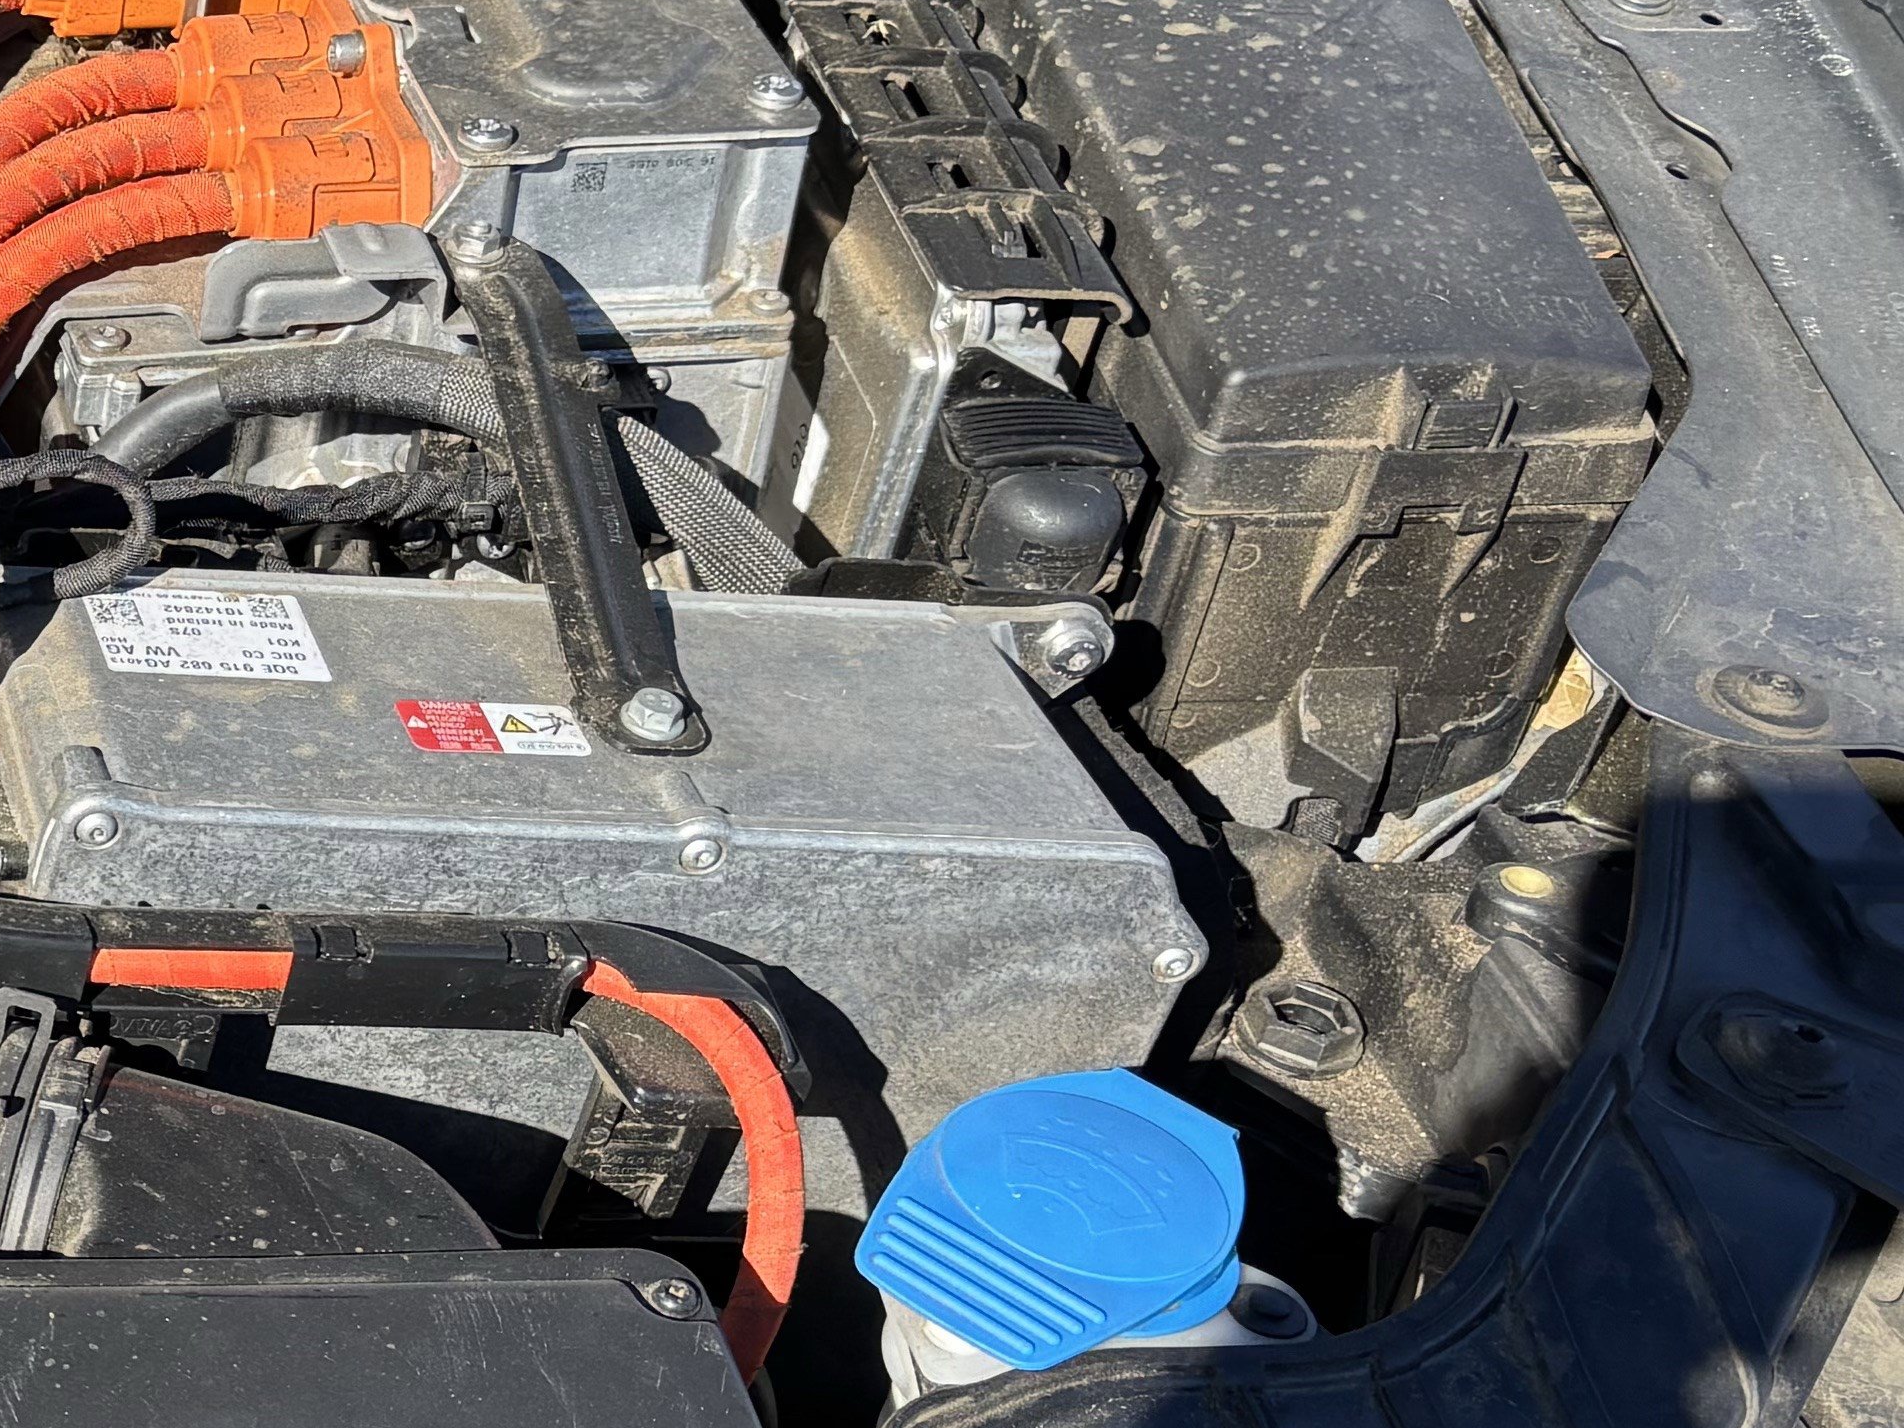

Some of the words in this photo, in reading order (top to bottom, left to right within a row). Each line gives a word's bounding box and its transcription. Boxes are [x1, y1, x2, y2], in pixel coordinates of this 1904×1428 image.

[250, 620, 293, 630] Made
[106, 644, 134, 655] AG
[145, 646, 181, 657] VW
